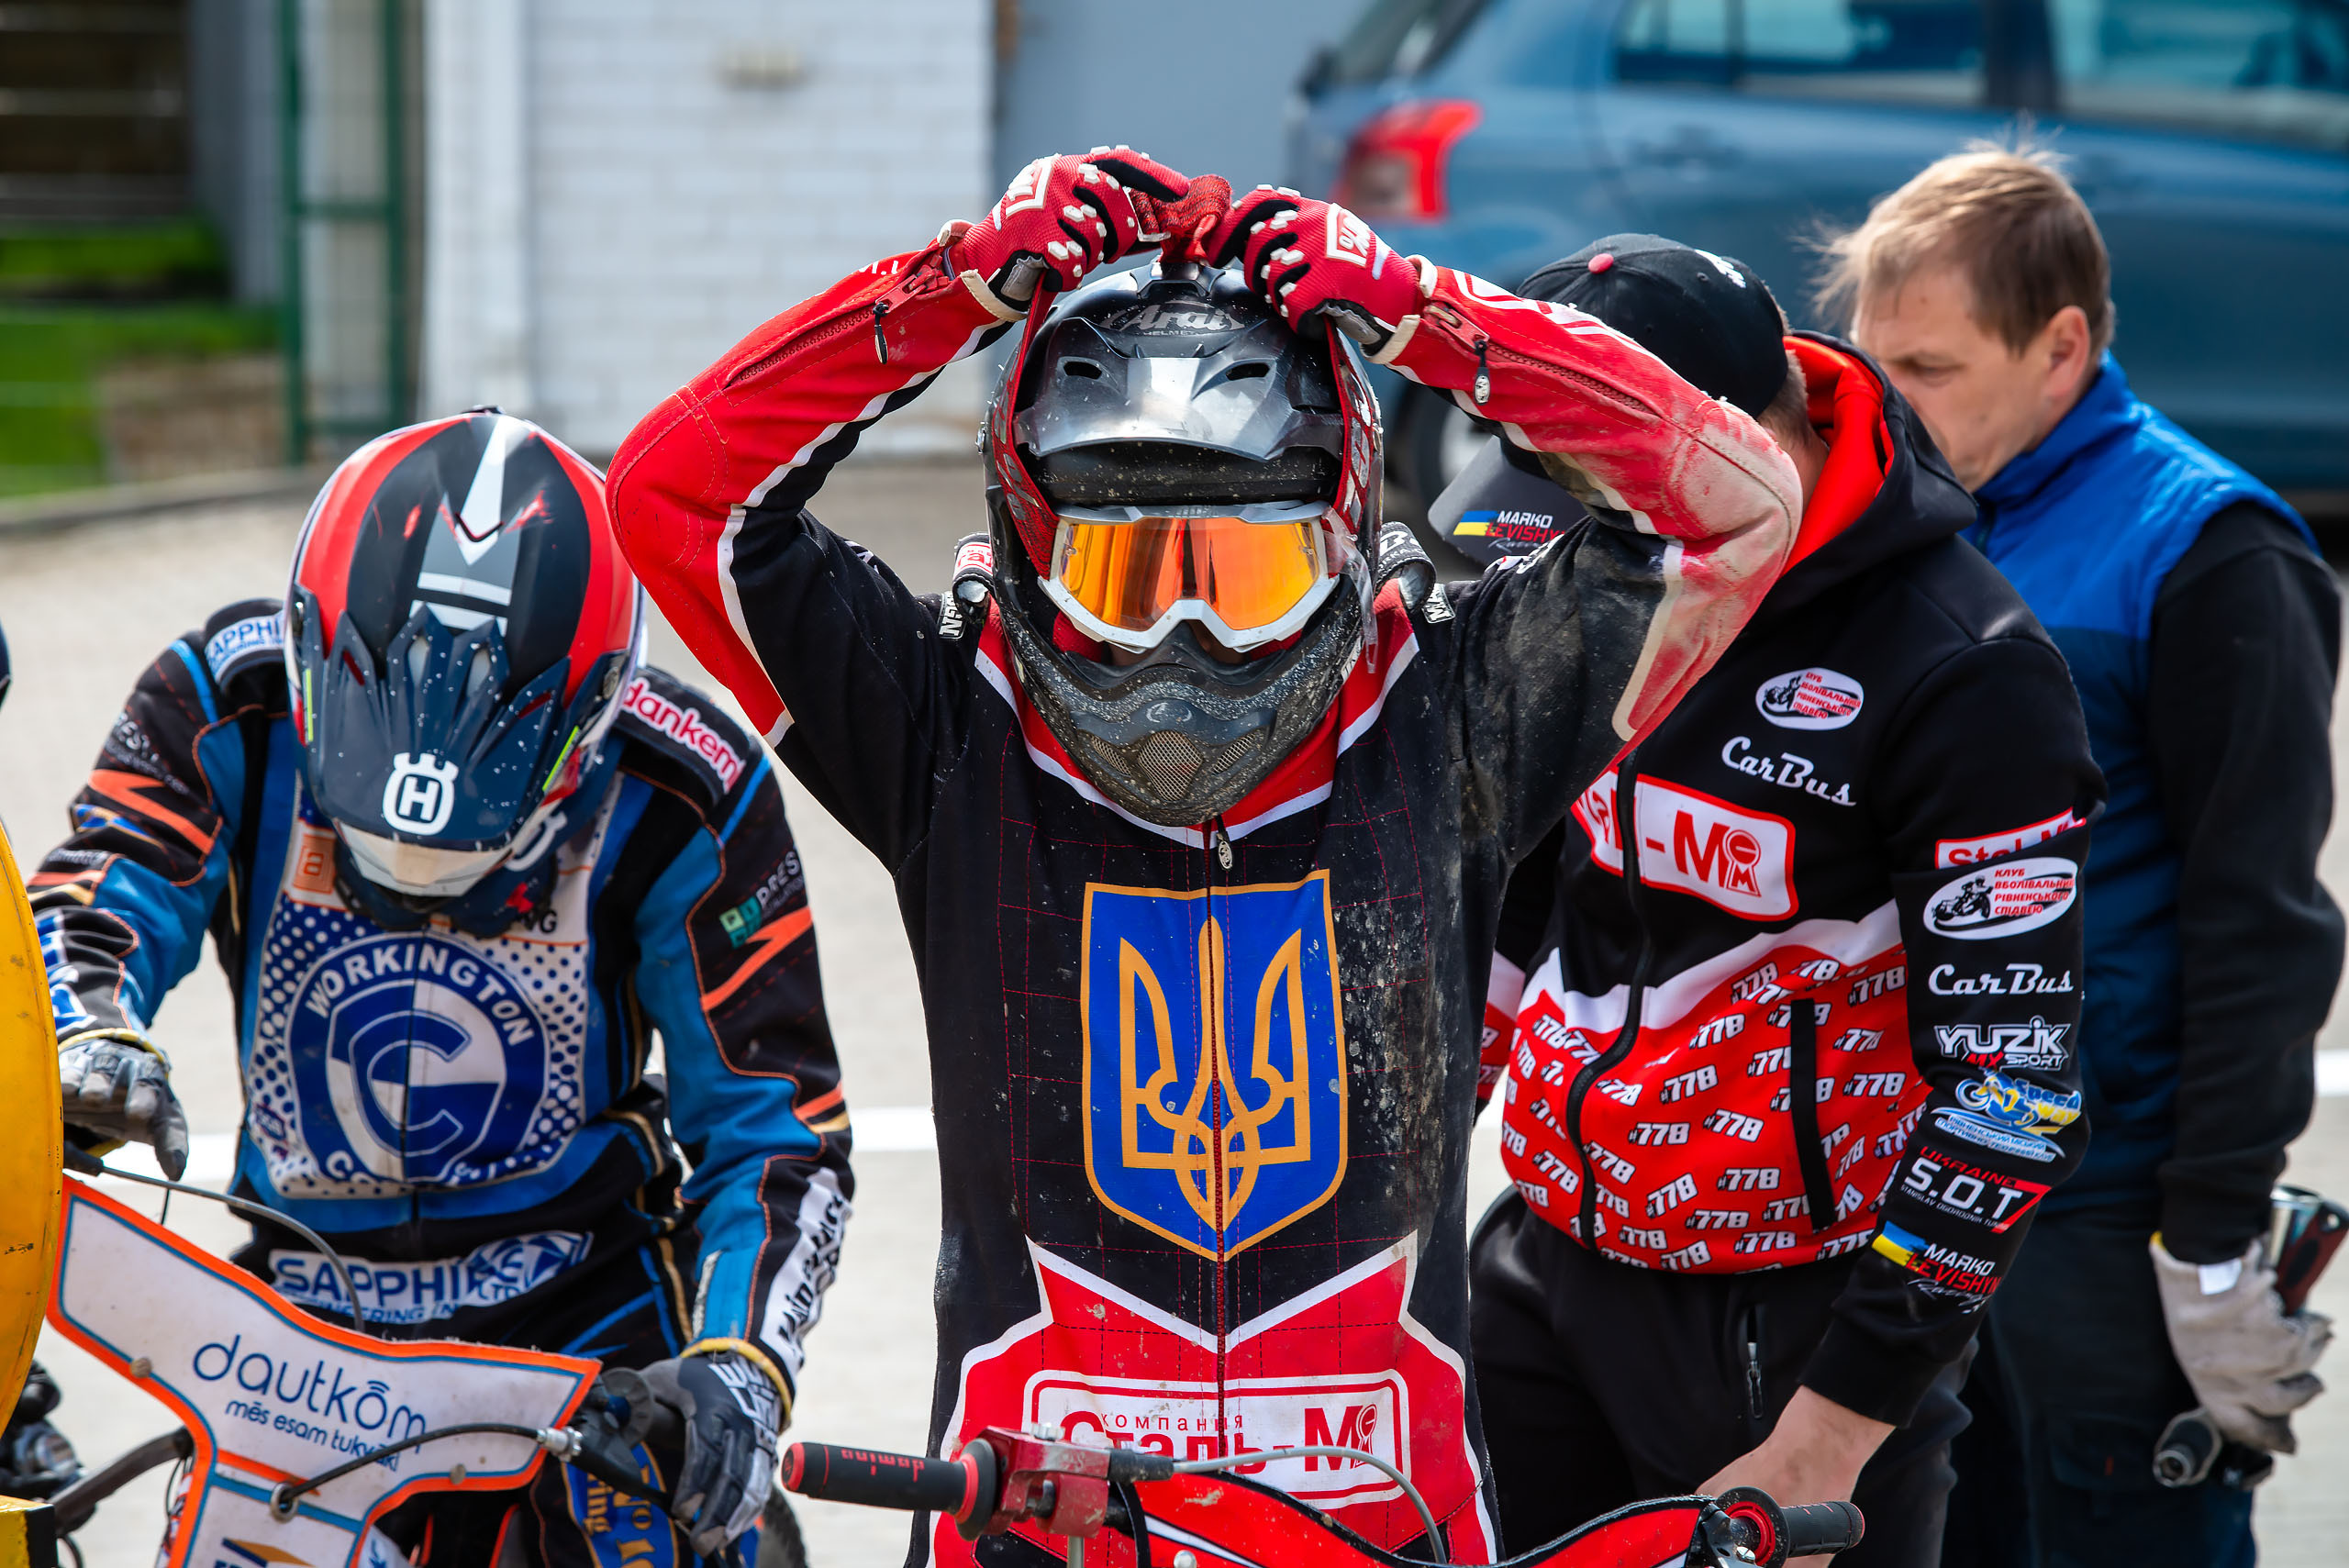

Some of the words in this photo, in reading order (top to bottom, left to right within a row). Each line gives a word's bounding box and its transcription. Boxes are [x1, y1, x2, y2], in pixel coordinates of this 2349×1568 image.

[1497, 510, 1553, 528] MARKO
[1485, 523, 1565, 544] LEVISHY
[1994, 868, 2026, 878] КЛУБ
[1994, 892, 2069, 902] РІВНЕНСЬКОГО
[1994, 903, 2043, 916] СПІДВЕЮ
[305, 943, 536, 1047] WORKINGTON
[1965, 1051, 2005, 1068] MX
[2005, 1054, 2064, 1068] SPORT
[1920, 1146, 2016, 1187] UKRAINE
[1924, 1242, 1996, 1277] MARKO
[1905, 1252, 2002, 1295] LEVISHYN
[273, 1414, 328, 1446] esam
